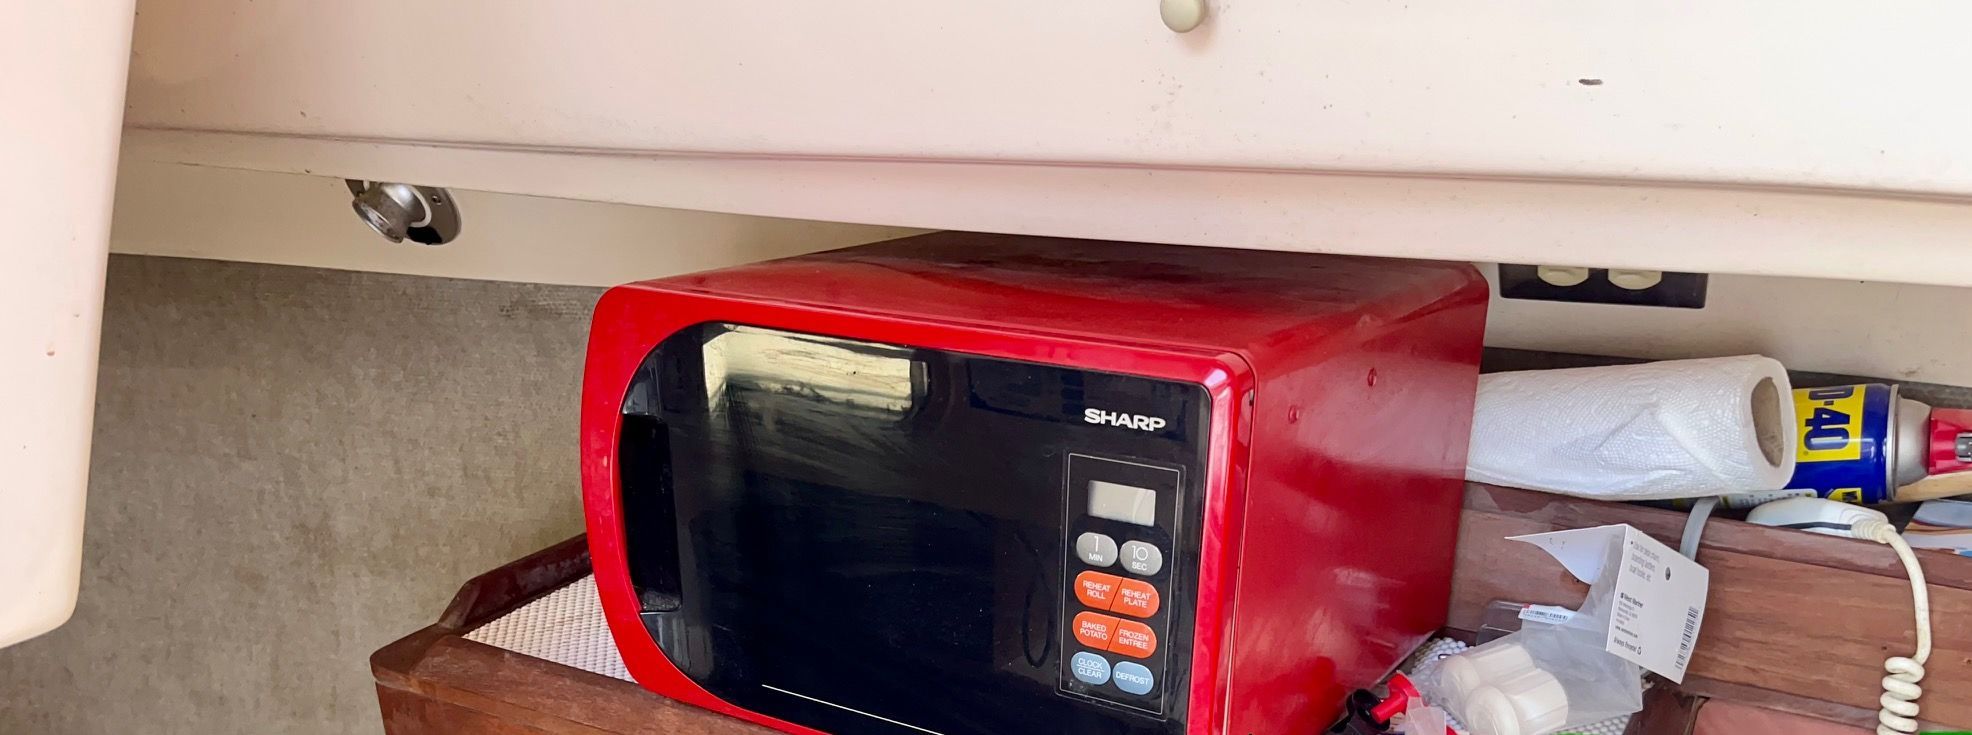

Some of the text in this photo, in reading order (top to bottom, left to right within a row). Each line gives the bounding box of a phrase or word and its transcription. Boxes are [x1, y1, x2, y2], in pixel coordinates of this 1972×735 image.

[1084, 408, 1166, 431] SHARP
[1094, 535, 1099, 552] 1
[1088, 552, 1103, 562] MIN
[1132, 545, 1148, 560] 10
[1131, 561, 1148, 571] SEC
[1082, 580, 1111, 591] REHEAT
[1086, 589, 1106, 599] ROLL
[1121, 588, 1151, 600] REHEAT
[1123, 597, 1148, 608] PLATE
[1081, 621, 1106, 632] BAKED
[1080, 628, 1107, 640] POTATO
[1119, 629, 1149, 641] FROZEN
[1118, 637, 1148, 649] ENTREE
[1078, 657, 1103, 669] CLOCK
[1077, 667, 1102, 678] CLEAR
[1115, 671, 1149, 685] DEFROST
